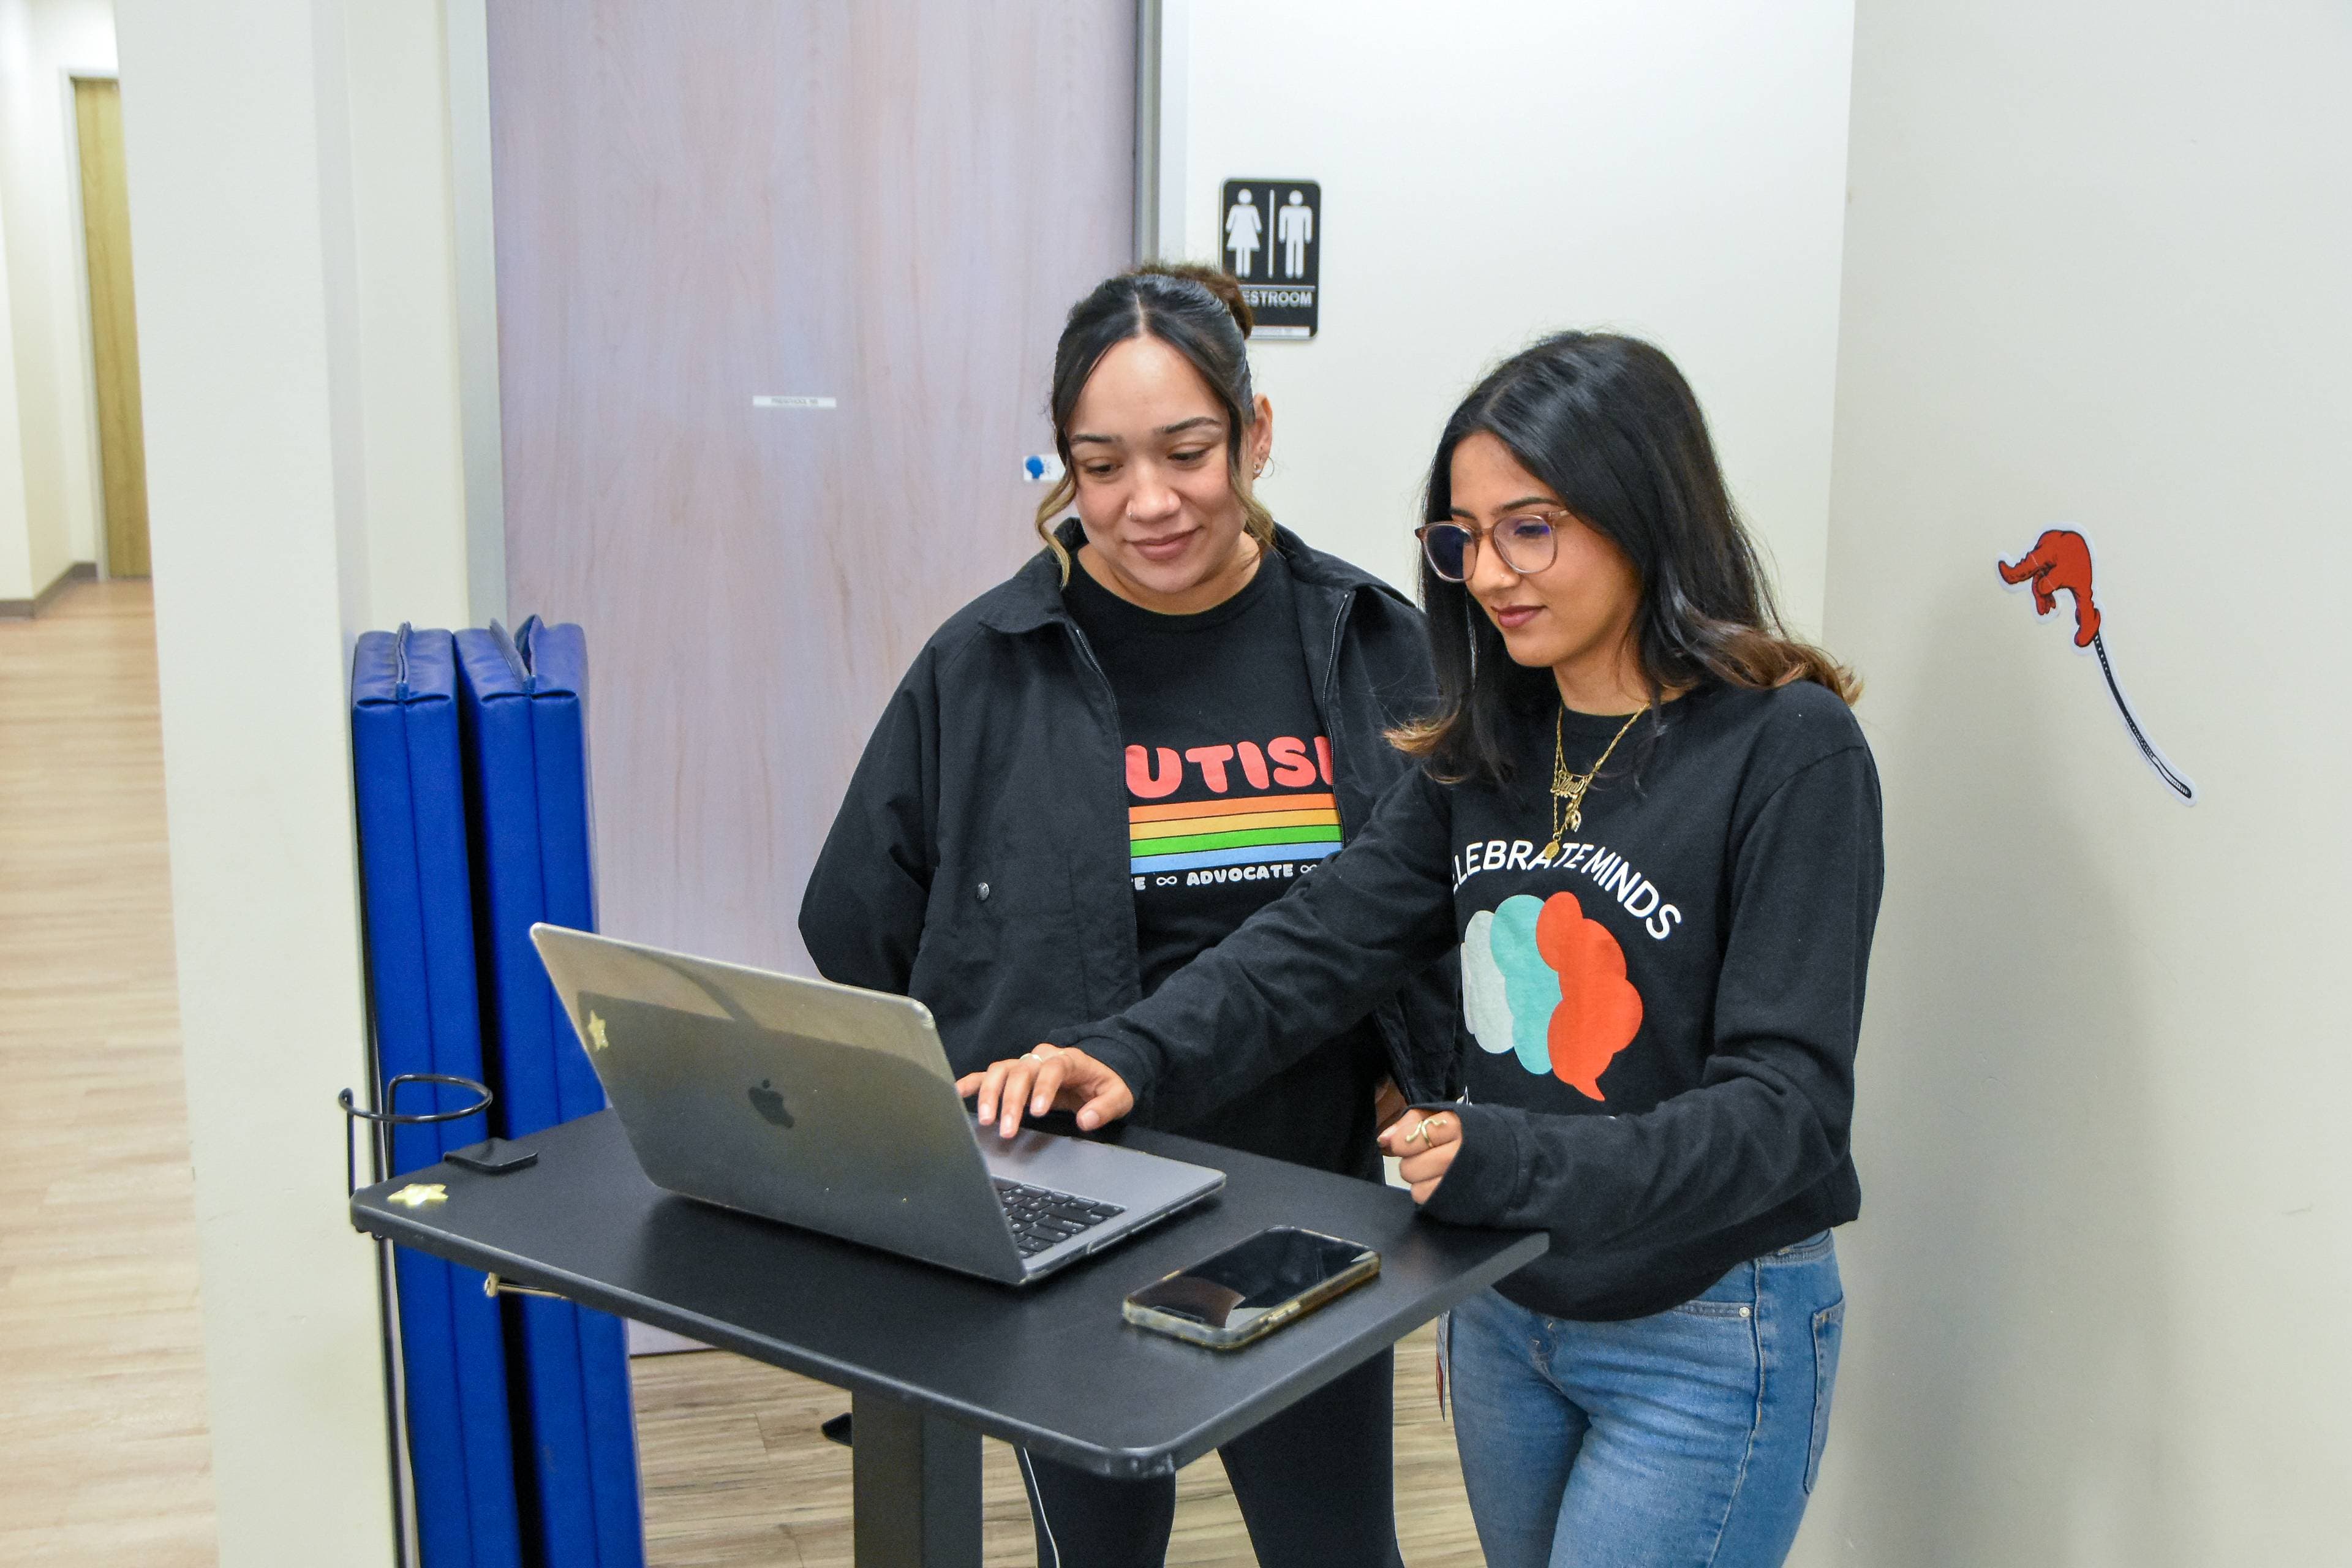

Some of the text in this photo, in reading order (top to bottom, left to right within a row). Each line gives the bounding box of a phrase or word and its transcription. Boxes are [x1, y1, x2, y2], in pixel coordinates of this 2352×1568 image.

[1242, 290, 1312, 307] ESTROOM
[1125, 736, 1333, 798] UTIS
[1186, 864, 1294, 886] ADVOCATE
[1452, 840, 1682, 940] LEBRATE MINDS
